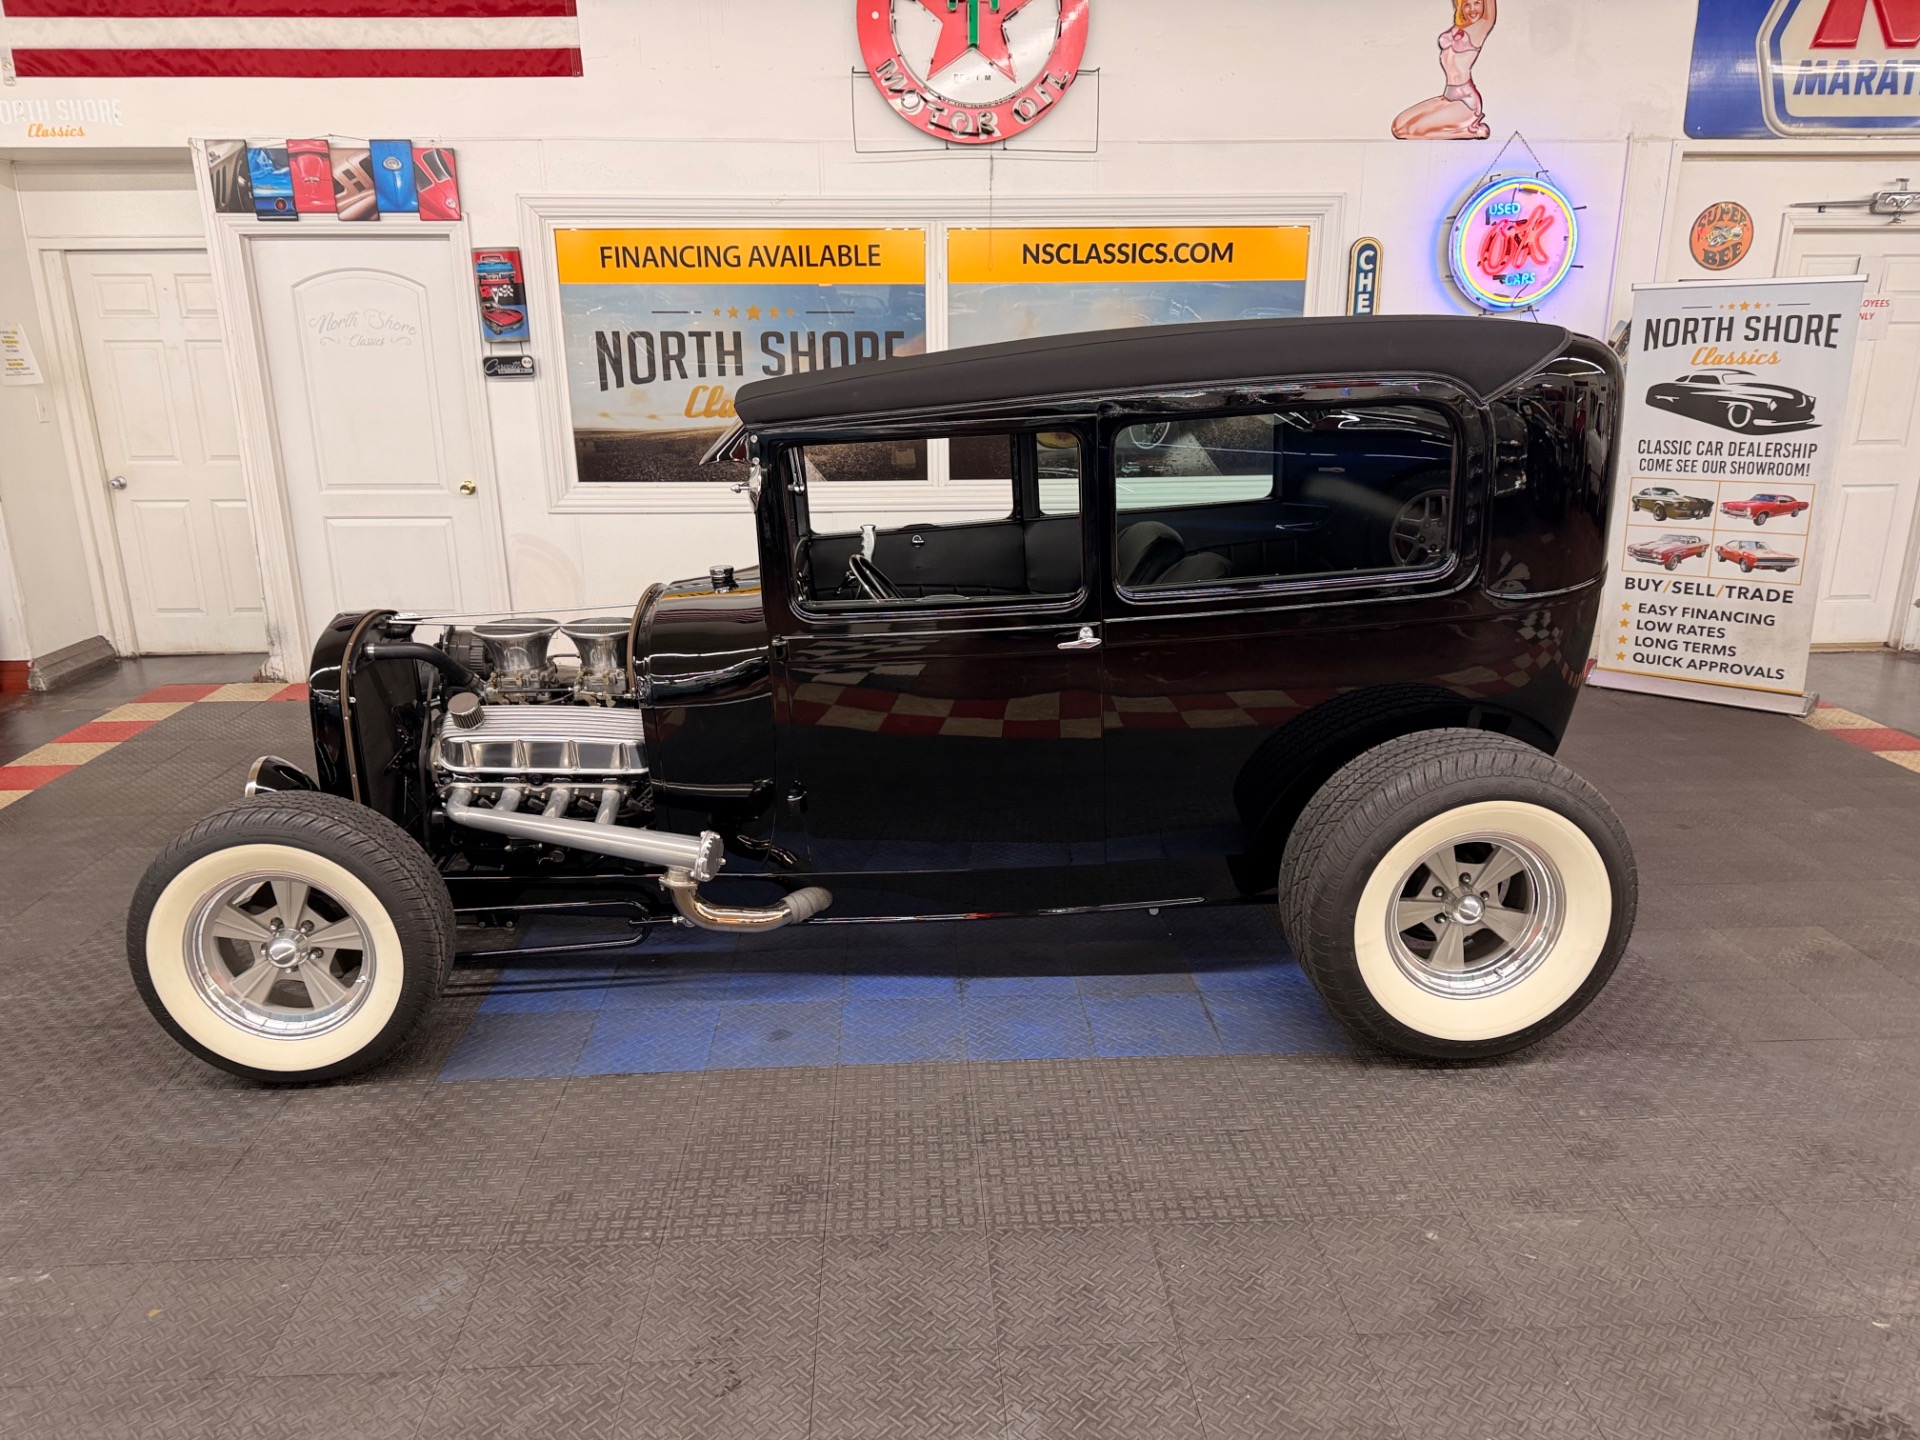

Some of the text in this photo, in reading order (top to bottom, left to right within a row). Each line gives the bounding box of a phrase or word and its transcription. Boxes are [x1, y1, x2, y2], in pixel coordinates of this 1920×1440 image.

[1792, 60, 1920, 96] MARAT
[875, 58, 1072, 139] MOTOR OIL
[0, 98, 124, 127] ORTH SHORE
[27, 122, 86, 138] Classics
[1488, 202, 1521, 216] USED
[1697, 203, 1748, 228] SUPER
[1480, 205, 1555, 275] OK
[599, 244, 881, 269] FINANCING AVAILABLE
[1022, 242, 1234, 265] NSCLASSICS.COM
[1702, 242, 1743, 266] BEE
[1355, 249, 1376, 314] CHE
[1504, 272, 1536, 286] CARS
[1860, 299, 1890, 308] OYEES
[309, 308, 418, 335] North Shore
[1859, 312, 1876, 321] NLY
[343, 333, 385, 348] Classics
[1643, 313, 1842, 352] NORTH SHORE
[595, 330, 744, 392] NORTH
[1690, 346, 1782, 366] Classics
[684, 384, 737, 419] Cla
[1637, 439, 1818, 459] CLASSIC CAR DEALERSHIP
[1639, 458, 1811, 477] COME SEE OUR SHOWROOM!
[1638, 602, 1776, 627] EASY FINANCING
[1636, 619, 1726, 639] LOW RATES
[1634, 635, 1737, 657] LONG TERMS
[1632, 652, 1785, 680] QUICK APPROVALS
